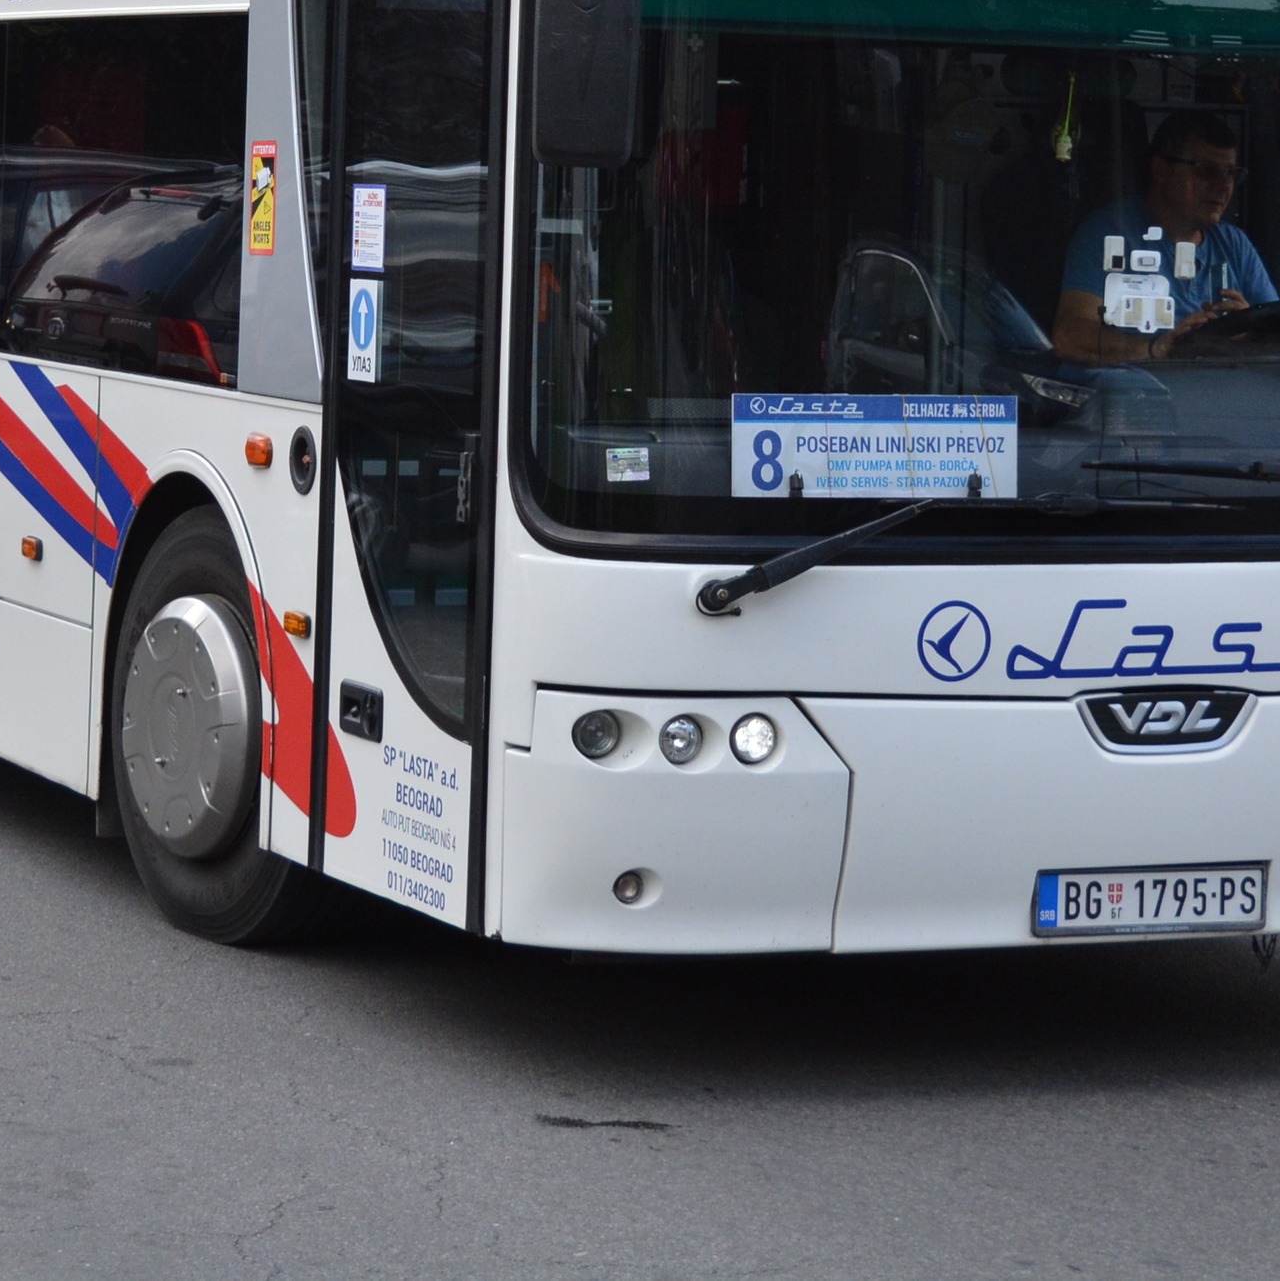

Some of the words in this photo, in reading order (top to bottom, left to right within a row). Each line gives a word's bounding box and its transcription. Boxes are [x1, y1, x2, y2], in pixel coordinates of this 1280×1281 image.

[352, 355, 372, 373] УЛАЗ
[768, 397, 864, 415] Lasta
[903, 403, 950, 417] DELHAIZE
[969, 403, 1005, 417] SERBIA
[796, 436, 870, 453] POSEBAN
[876, 436, 940, 453] LINIJSKI
[946, 436, 1005, 453] PREVOZ
[751, 429, 783, 491] 8
[827, 460, 852, 471] OMV
[855, 460, 892, 471] PUMPA
[816, 476, 848, 488] IVEKO
[896, 476, 930, 488] STARA
[1108, 699, 1221, 736] VDL
[383, 744, 397, 767] SP
[440, 767, 459, 791] a.d.
[396, 782, 443, 818] BEOGRAD
[411, 819, 440, 845] BEOGRAD
[451, 835, 456, 852] 4
[382, 838, 409, 866] 11050
[410, 849, 454, 884] BEOGRAD
[387, 870, 446, 912] 011/3402300
[1064, 880, 1102, 921] BG
[1039, 909, 1055, 921] SRB
